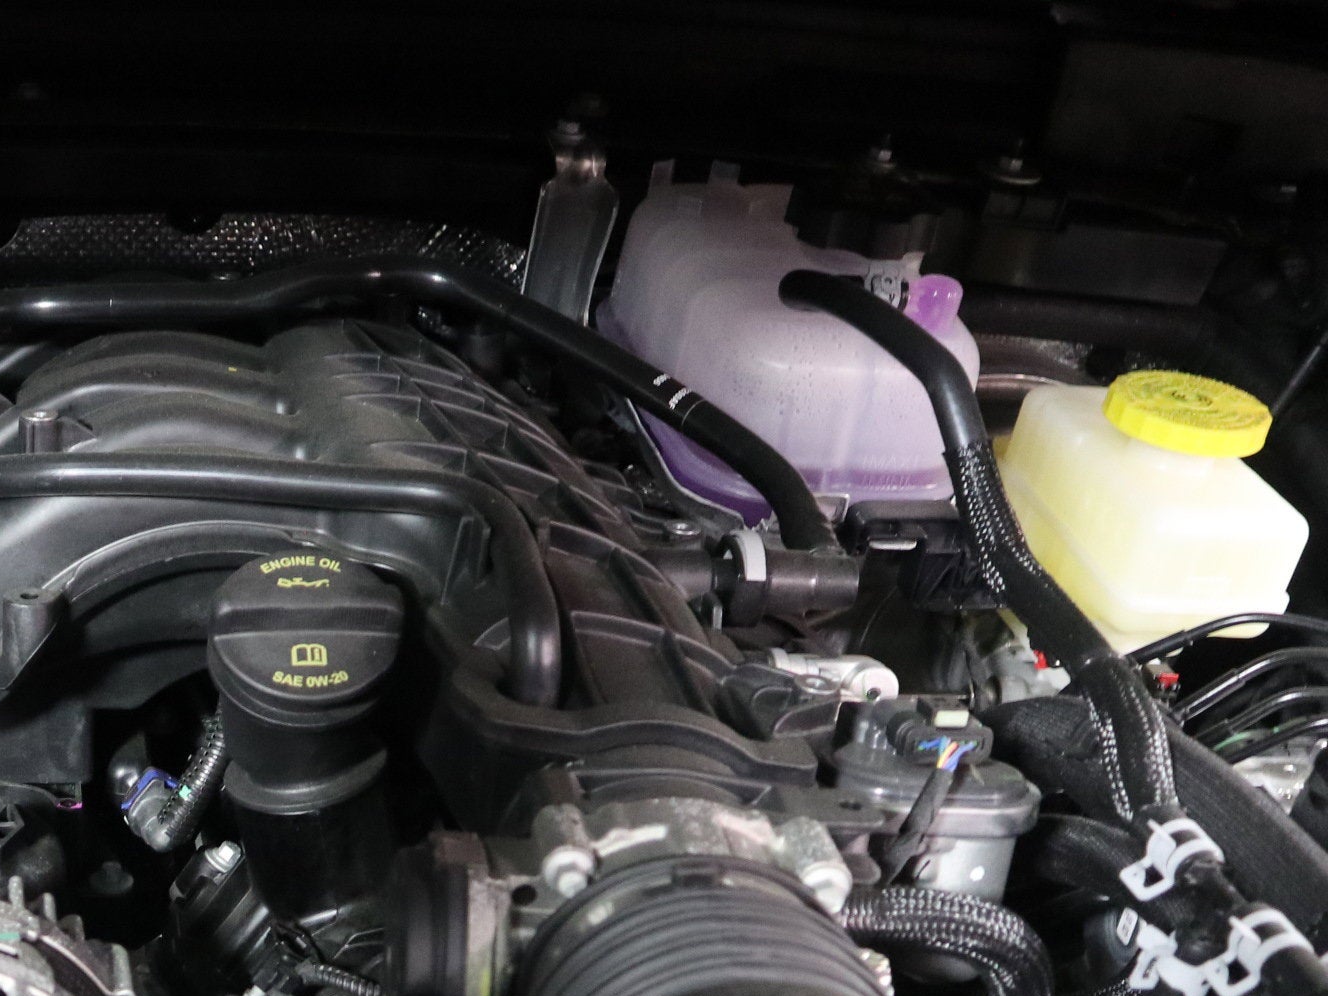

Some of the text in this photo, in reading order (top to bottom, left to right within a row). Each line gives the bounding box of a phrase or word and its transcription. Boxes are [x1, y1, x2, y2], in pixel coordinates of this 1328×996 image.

[260, 555, 342, 574] ENGINE OIL
[272, 670, 349, 688] SAE 0W-20
